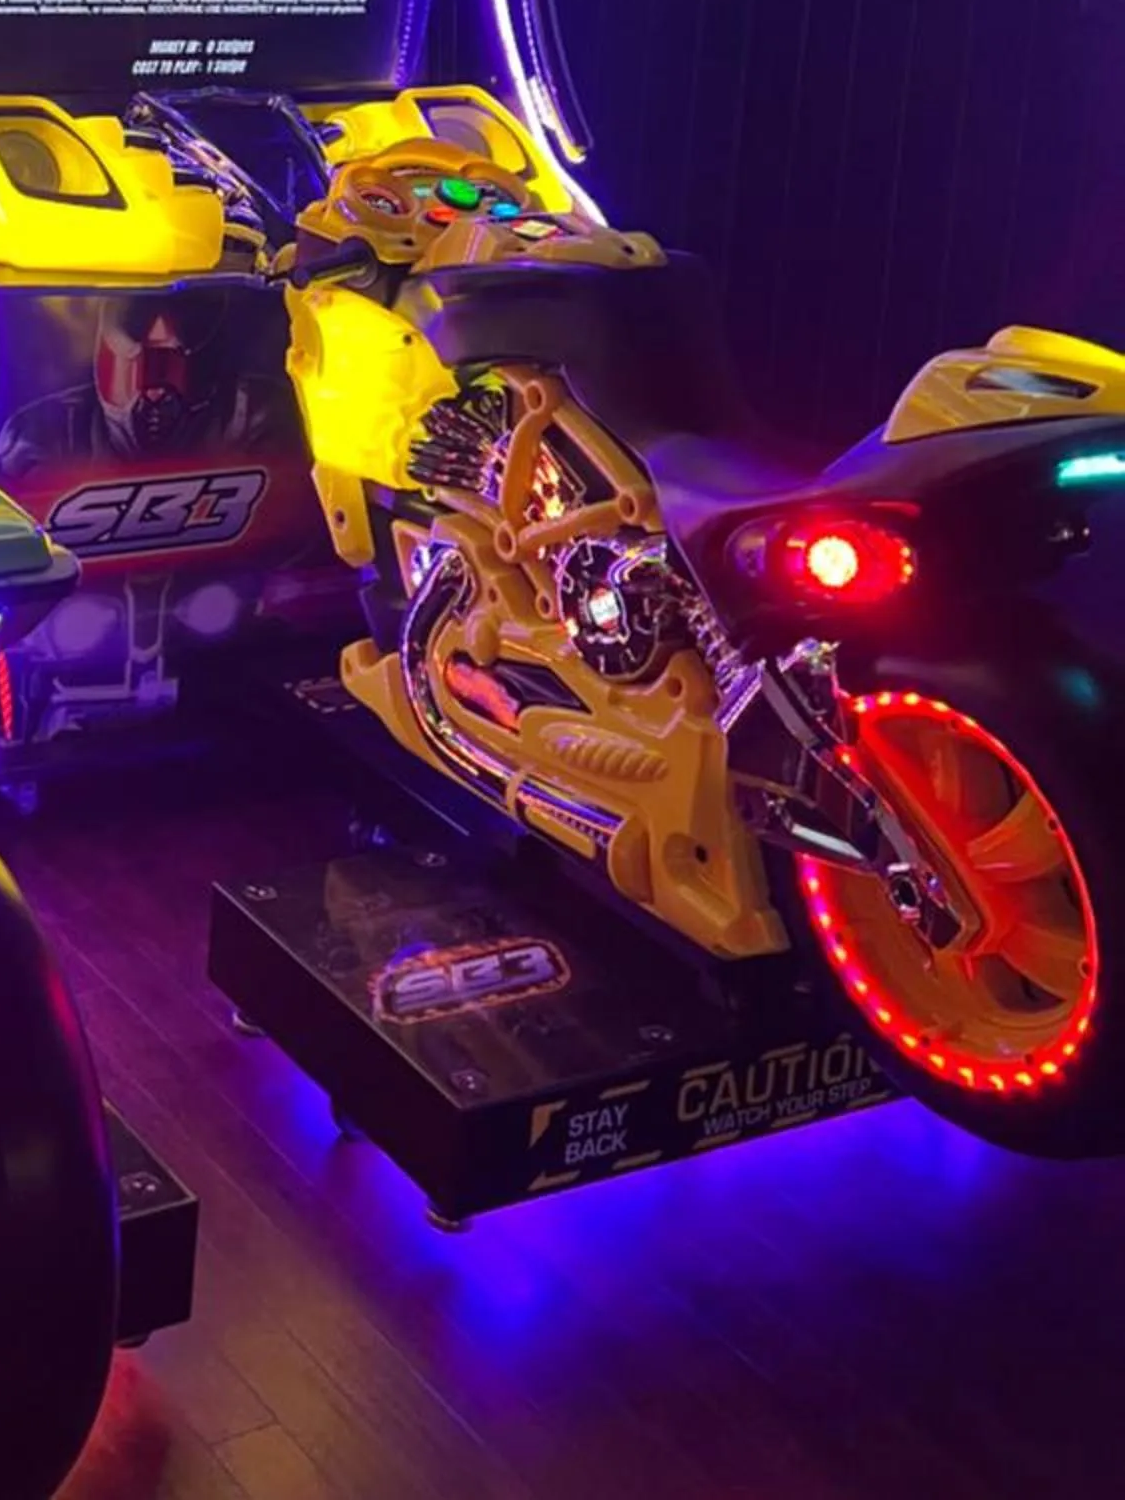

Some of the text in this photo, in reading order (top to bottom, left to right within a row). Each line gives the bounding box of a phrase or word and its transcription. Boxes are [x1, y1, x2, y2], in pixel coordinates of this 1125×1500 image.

[49, 470, 267, 558] SB3
[393, 945, 557, 1013] SB3
[568, 1103, 629, 1137] STAY
[703, 1077, 872, 1136] WATCH YOUR STEP
[565, 1130, 628, 1164] BACK
